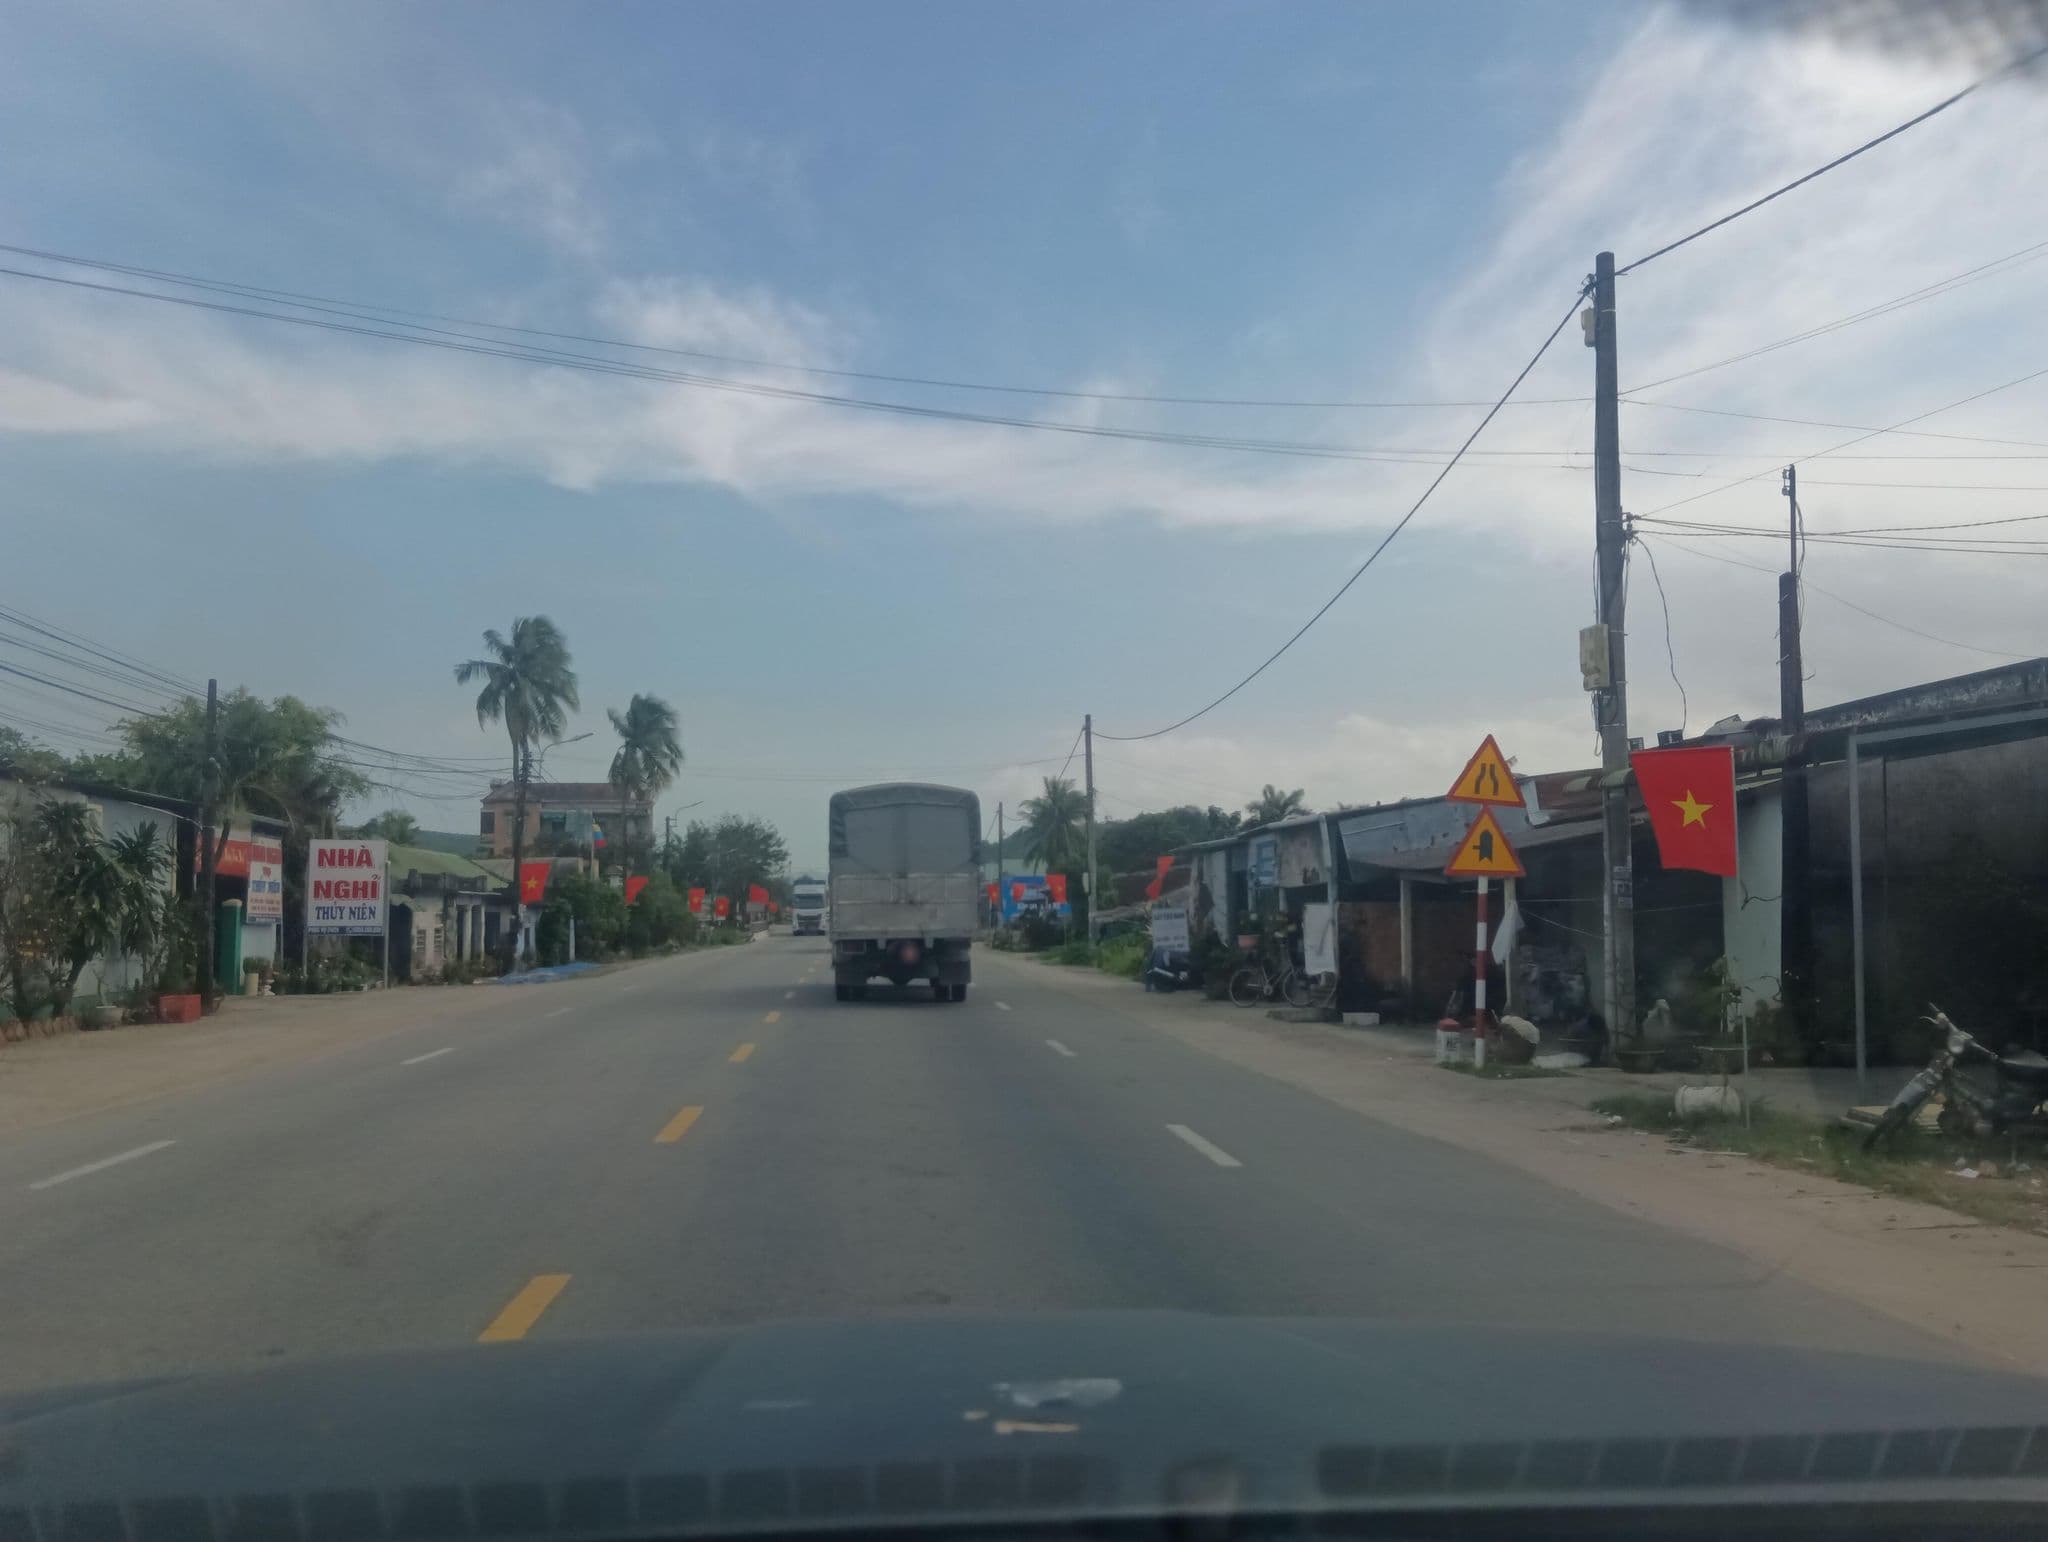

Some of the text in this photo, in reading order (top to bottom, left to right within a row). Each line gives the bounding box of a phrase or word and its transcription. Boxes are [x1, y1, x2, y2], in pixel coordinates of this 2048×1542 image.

[317, 845, 374, 867] NHÀ
[313, 874, 380, 899] NGHỈ
[315, 901, 376, 921] THỦY NIÊN
